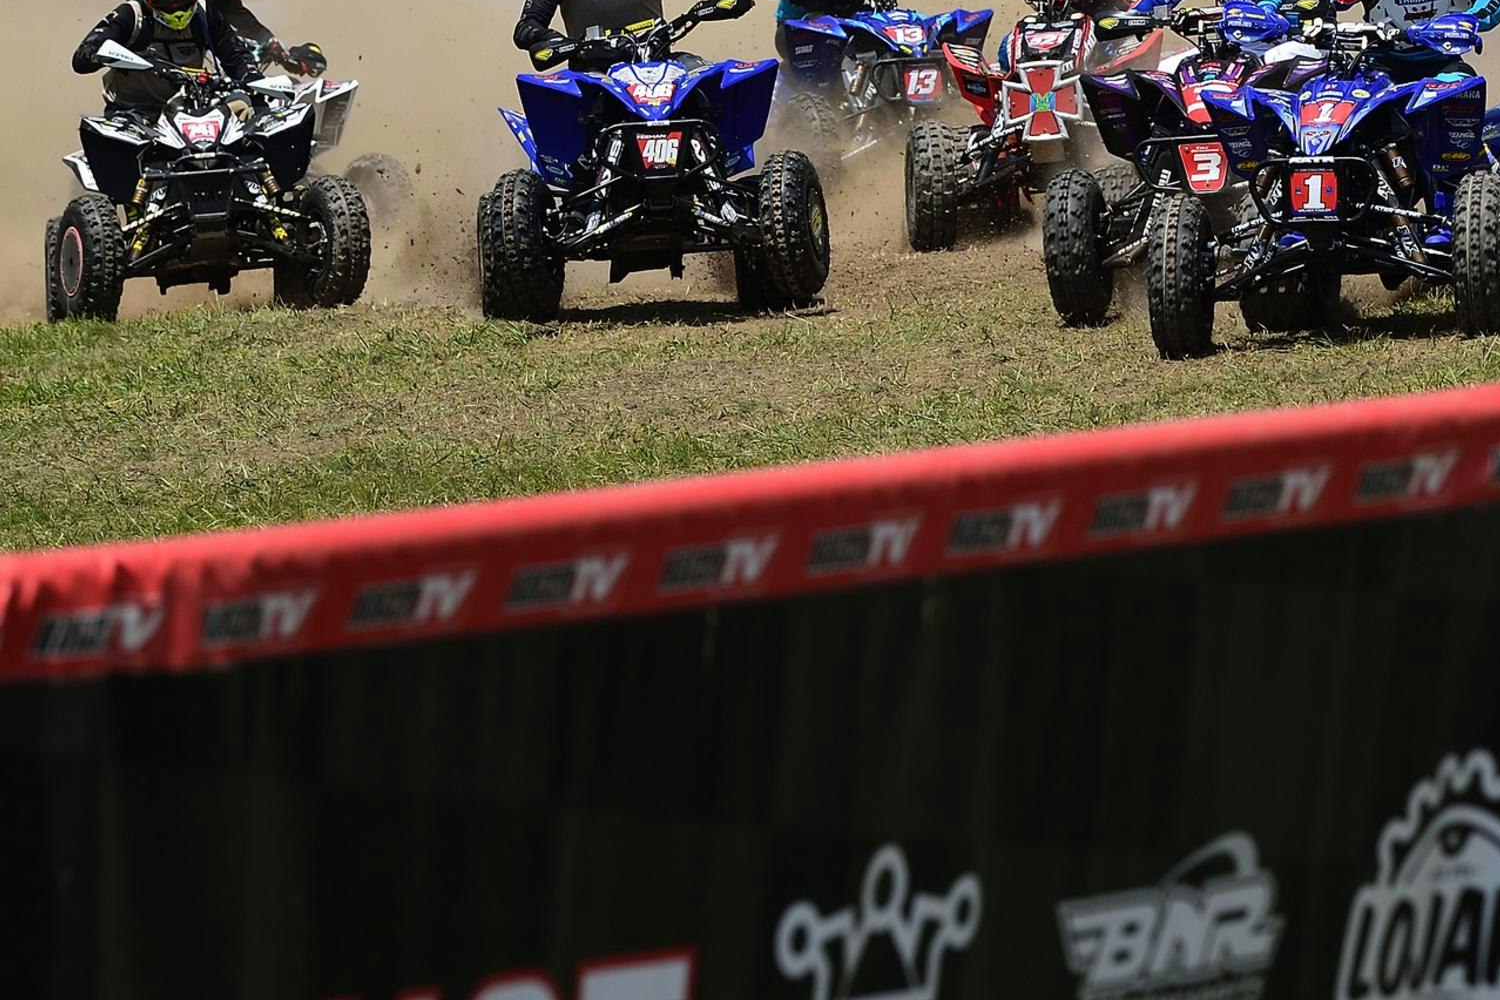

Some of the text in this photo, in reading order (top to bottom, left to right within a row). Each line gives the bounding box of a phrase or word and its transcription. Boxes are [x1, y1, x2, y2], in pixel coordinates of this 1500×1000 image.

[894, 26, 925, 44] 13
[905, 68, 938, 95] 13
[1312, 102, 1337, 123] 1
[641, 139, 679, 164] 406
[1190, 152, 1222, 182] 3
[1303, 174, 1326, 210] 1
